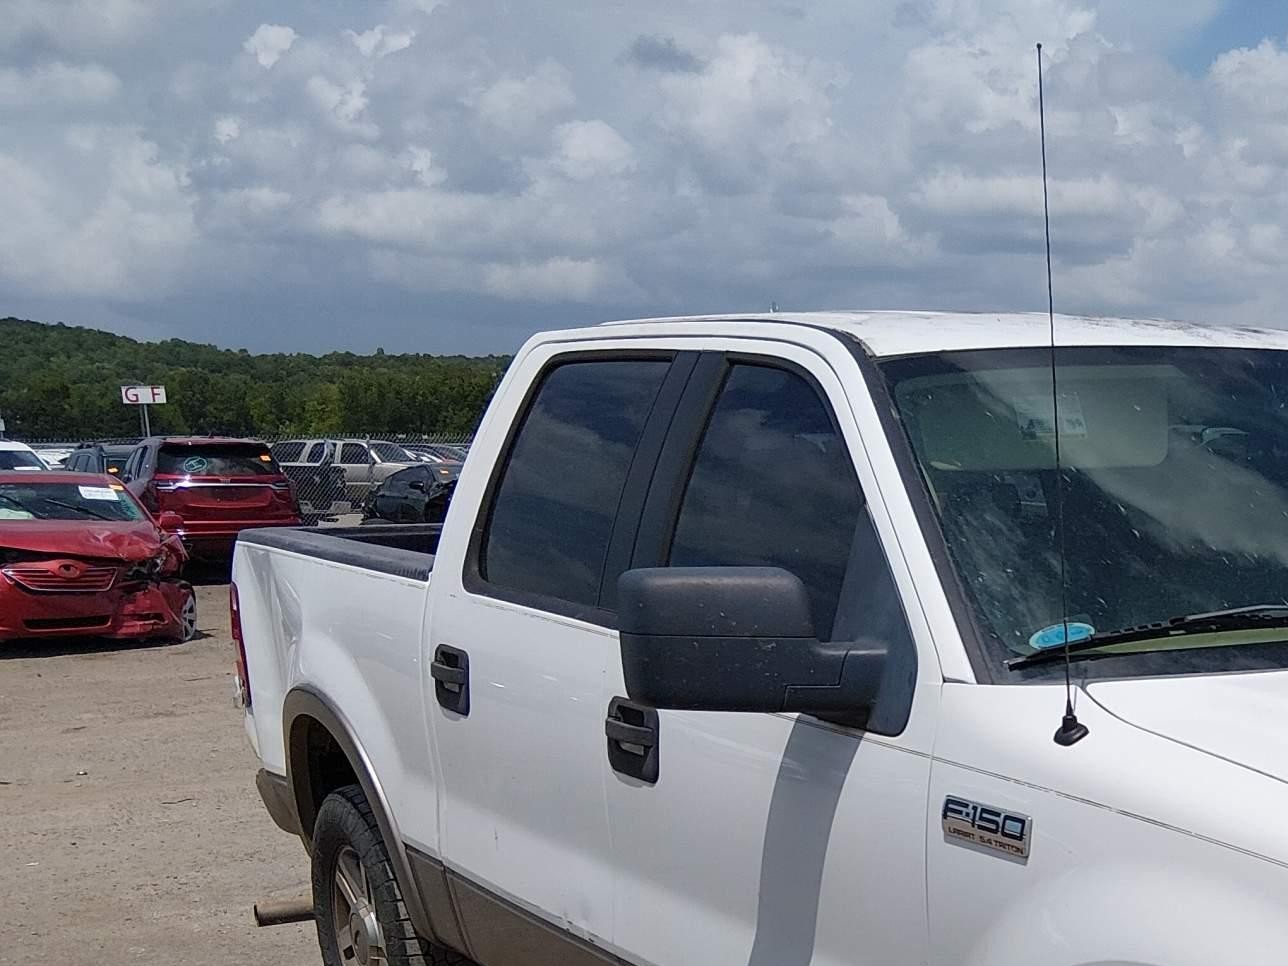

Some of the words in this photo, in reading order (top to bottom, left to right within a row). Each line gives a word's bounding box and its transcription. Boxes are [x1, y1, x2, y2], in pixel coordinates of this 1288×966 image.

[125, 387, 139, 403] G
[151, 386, 160, 402] F
[943, 798, 1026, 842] F-150
[993, 840, 1024, 855] TRITON
